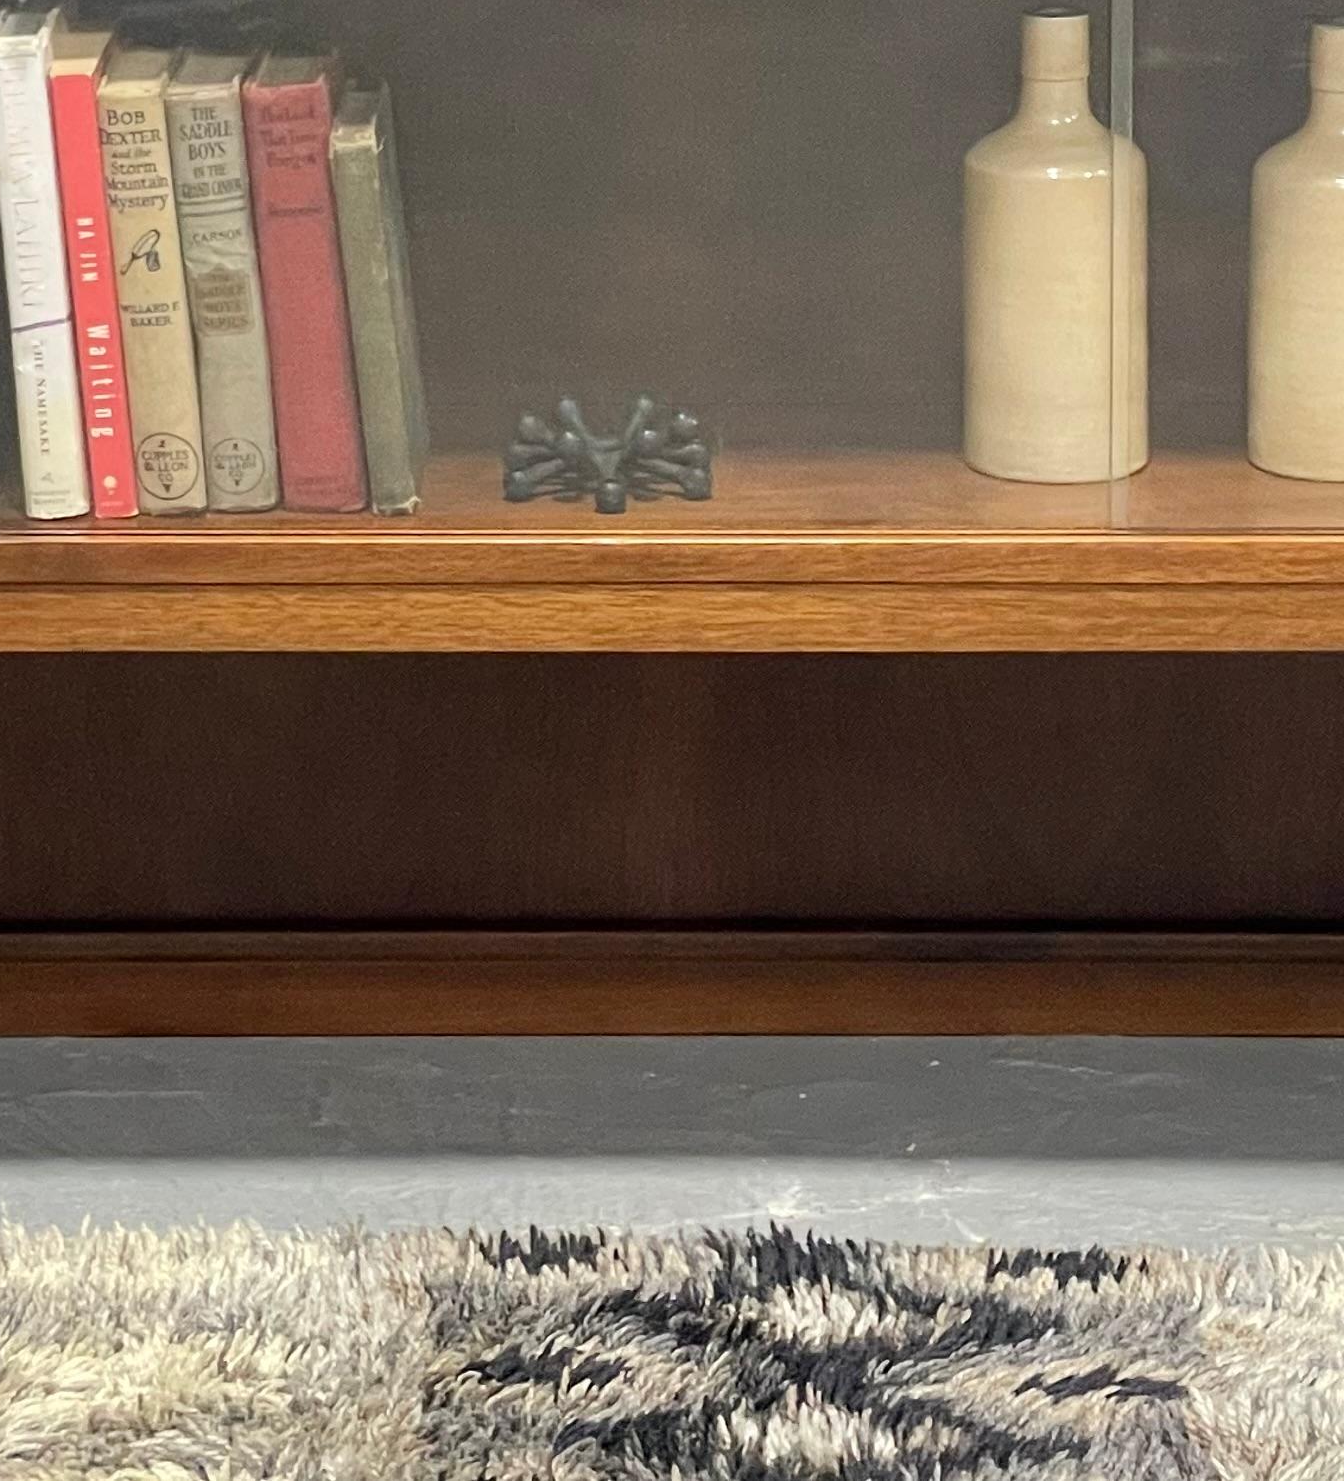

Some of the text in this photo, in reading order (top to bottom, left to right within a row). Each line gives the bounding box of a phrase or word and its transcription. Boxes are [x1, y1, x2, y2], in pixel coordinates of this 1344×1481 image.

[105, 109, 147, 127] BOB
[191, 106, 217, 123] THE
[99, 128, 163, 146] DEXTER
[178, 120, 233, 142] SADDLE
[188, 141, 227, 161] BOYS
[111, 160, 158, 176] Storm
[208, 163, 227, 177] THE
[106, 175, 169, 192] Mountain
[107, 193, 170, 214] Mystery
[192, 228, 243, 244] CARSON
[75, 217, 99, 282] HA JIN
[120, 302, 169, 315] WILLARD
[130, 315, 173, 328] BAKER
[86, 324, 117, 439] Waiting
[35, 378, 52, 457] NAMESAKE
